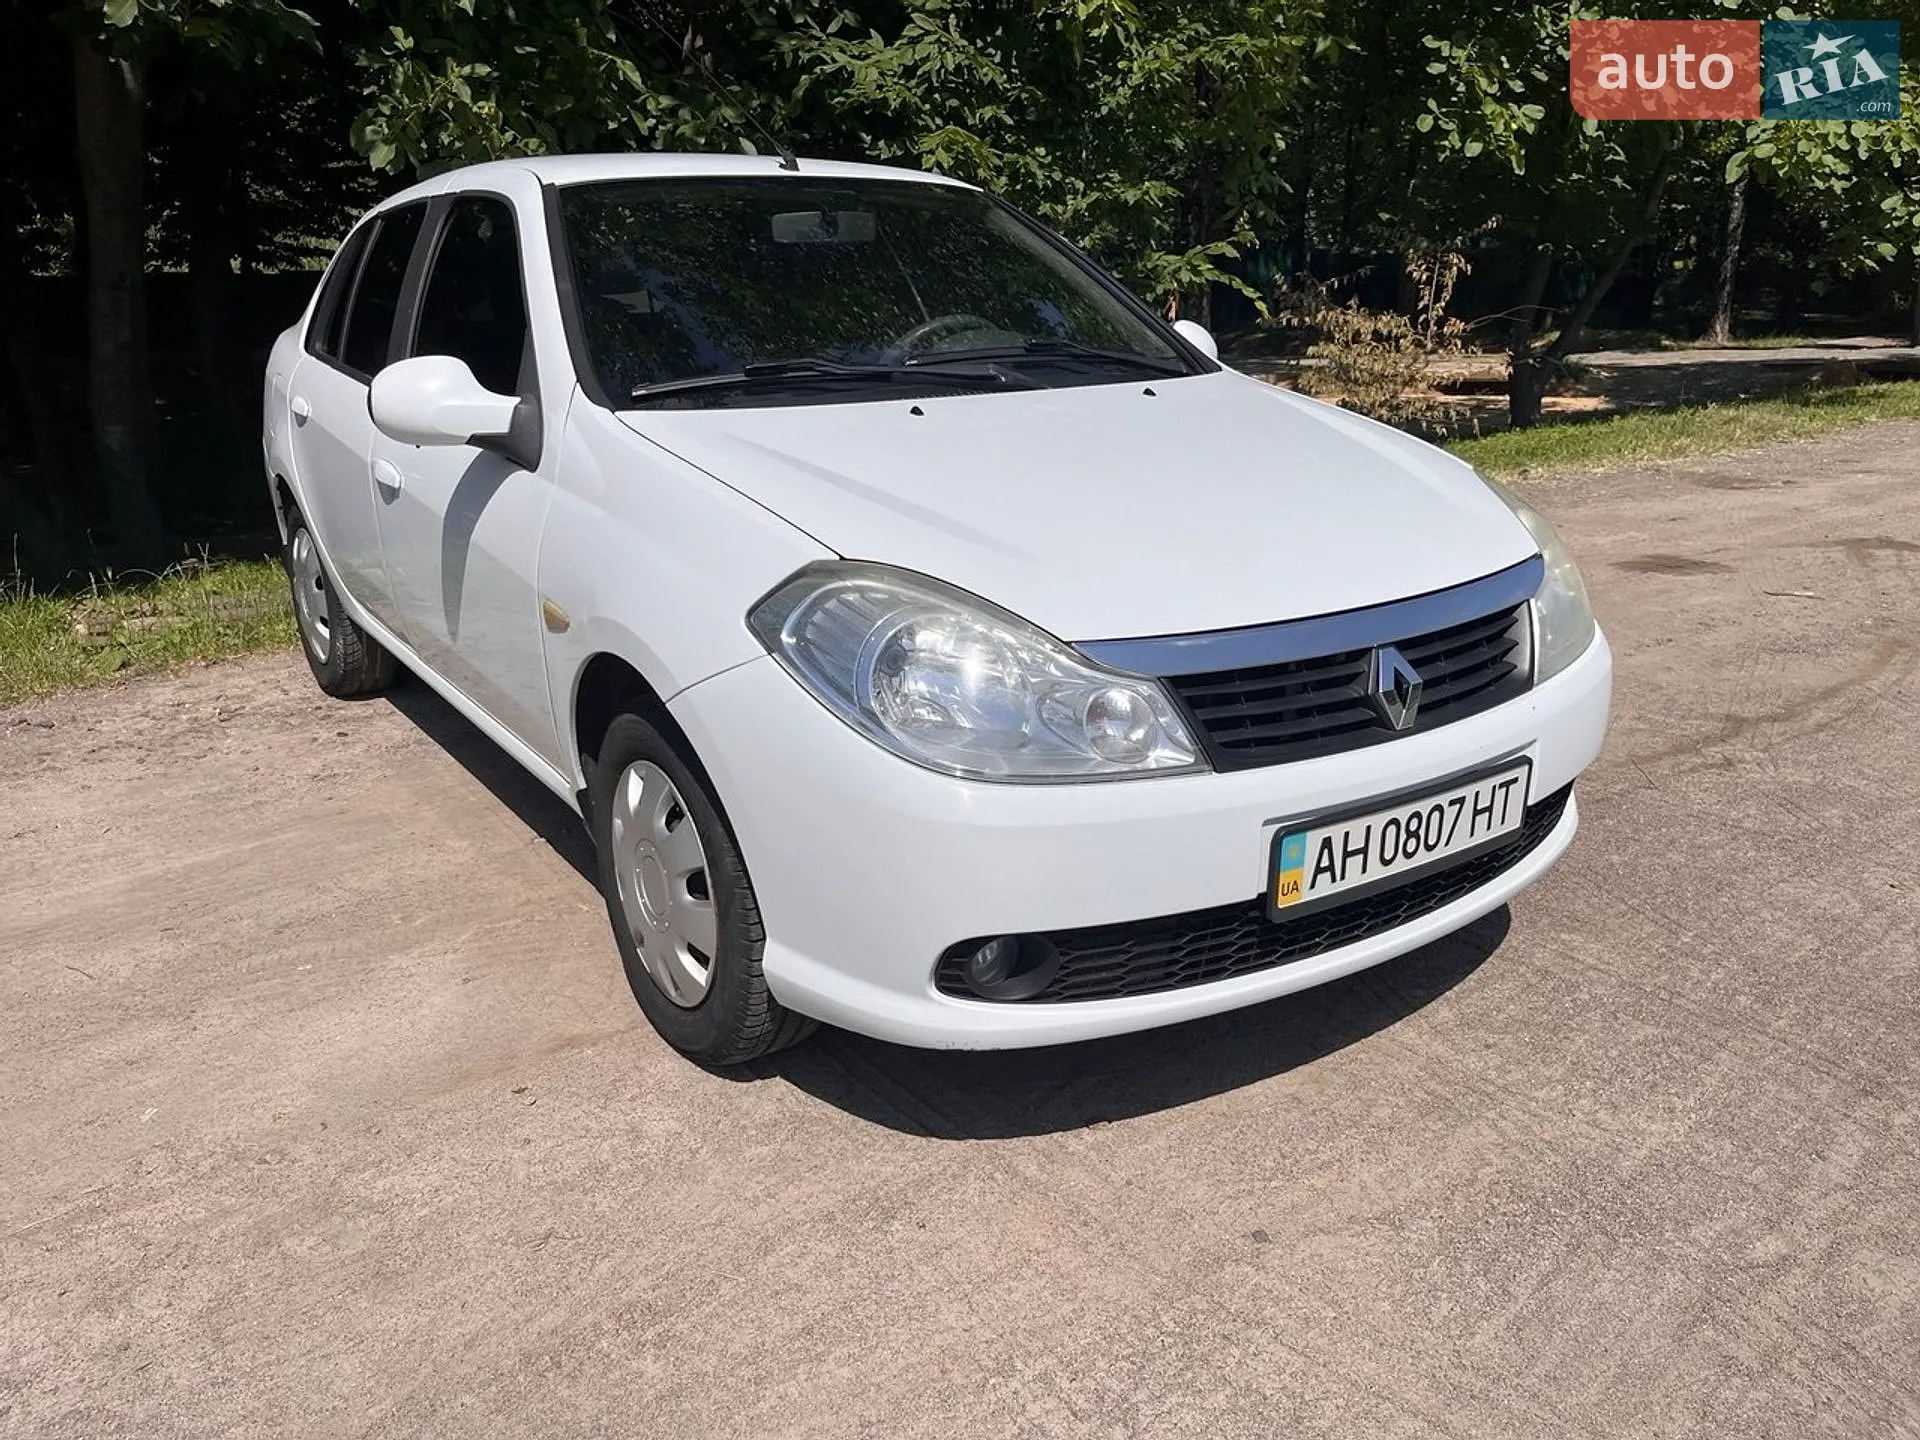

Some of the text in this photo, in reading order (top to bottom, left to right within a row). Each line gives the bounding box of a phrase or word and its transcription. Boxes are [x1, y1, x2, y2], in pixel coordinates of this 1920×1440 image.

[1308, 776, 1519, 890] AH 0807 HT
[1280, 879, 1301, 897] UA
